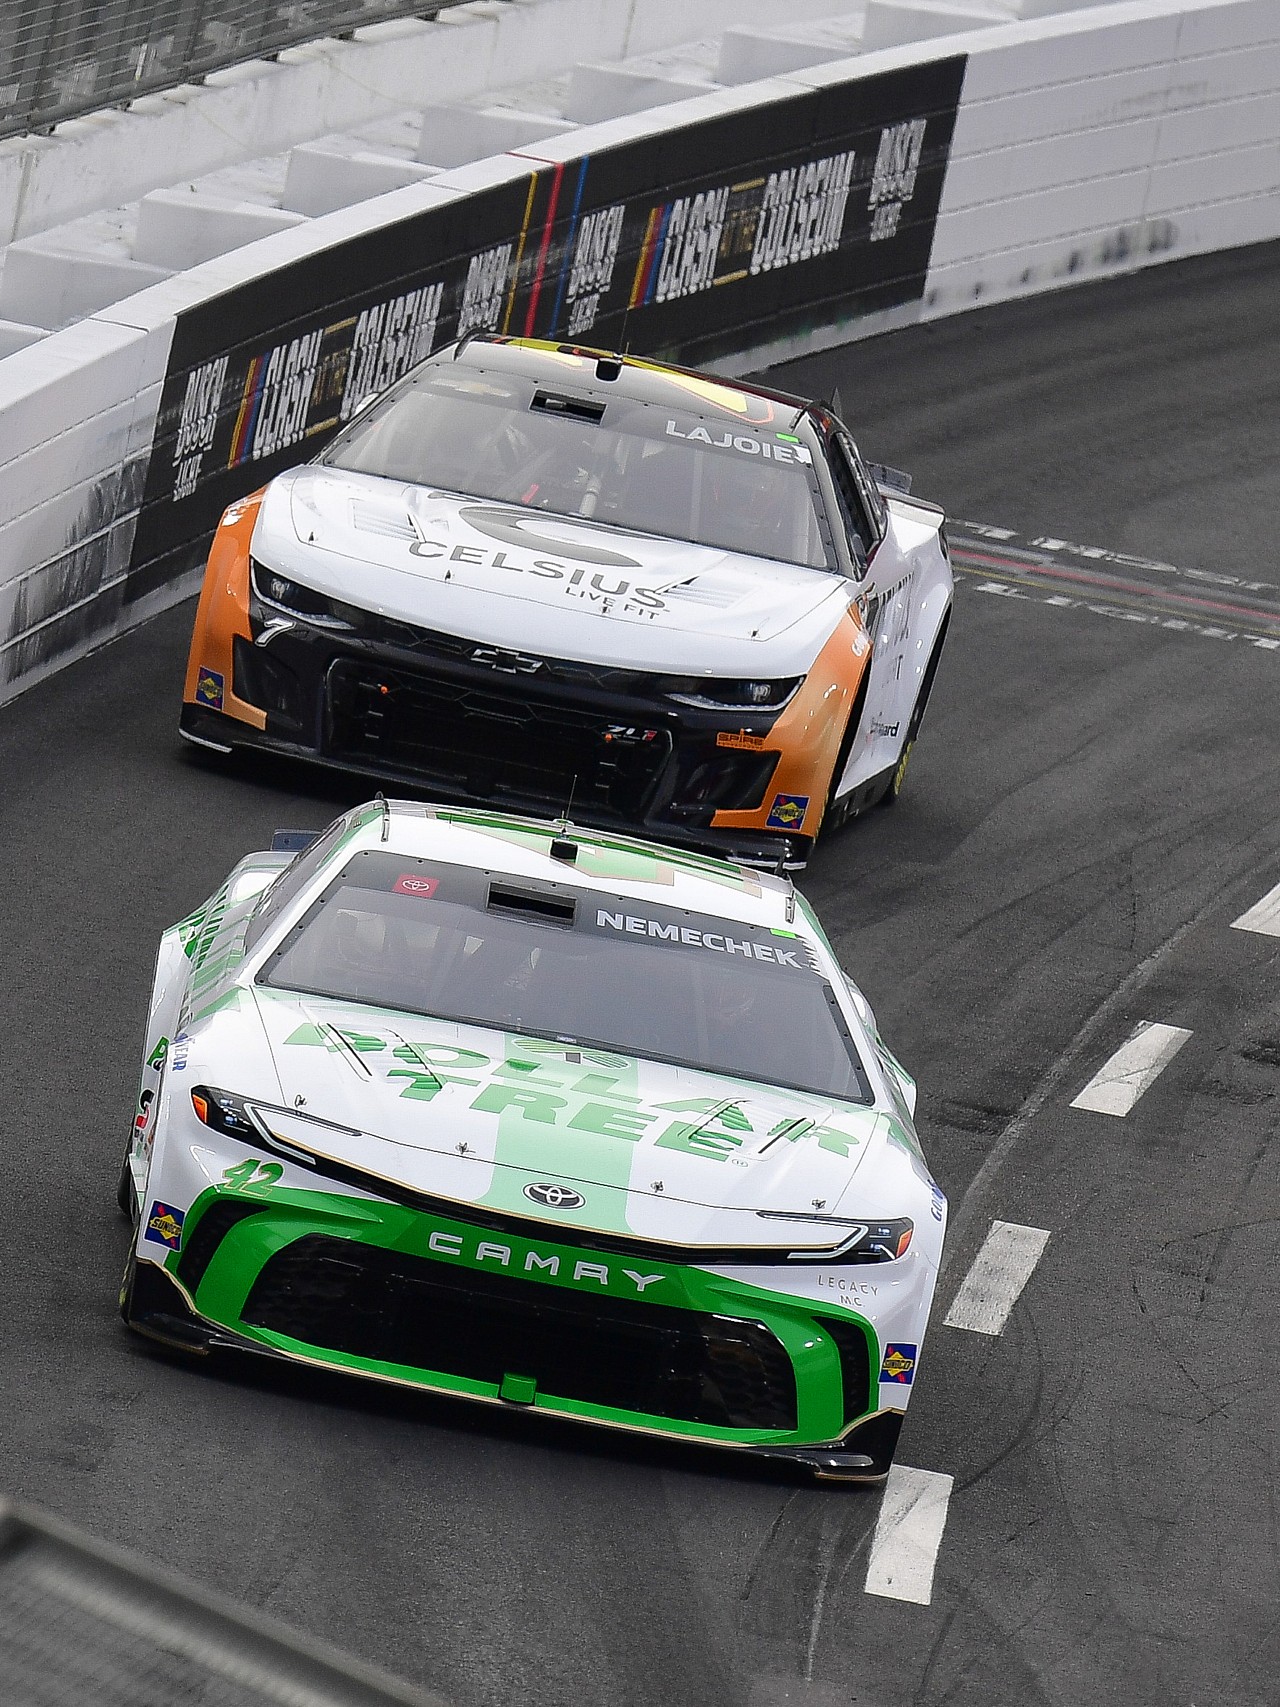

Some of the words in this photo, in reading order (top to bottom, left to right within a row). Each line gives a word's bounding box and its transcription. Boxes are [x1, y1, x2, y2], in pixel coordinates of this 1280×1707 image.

[665, 420, 795, 465] LAJOIE
[408, 541, 666, 609] CELSIUS
[565, 586, 617, 608] LIVE
[623, 603, 661, 620] FIT
[254, 616, 297, 648] 7
[595, 909, 804, 970] NEMECHEK
[386, 1068, 745, 1162] TREE
[221, 1158, 284, 1198] 42
[150, 1216, 183, 1237] SUNOCO
[428, 1231, 667, 1292] CAMRY
[817, 1274, 879, 1297] LEGACY
